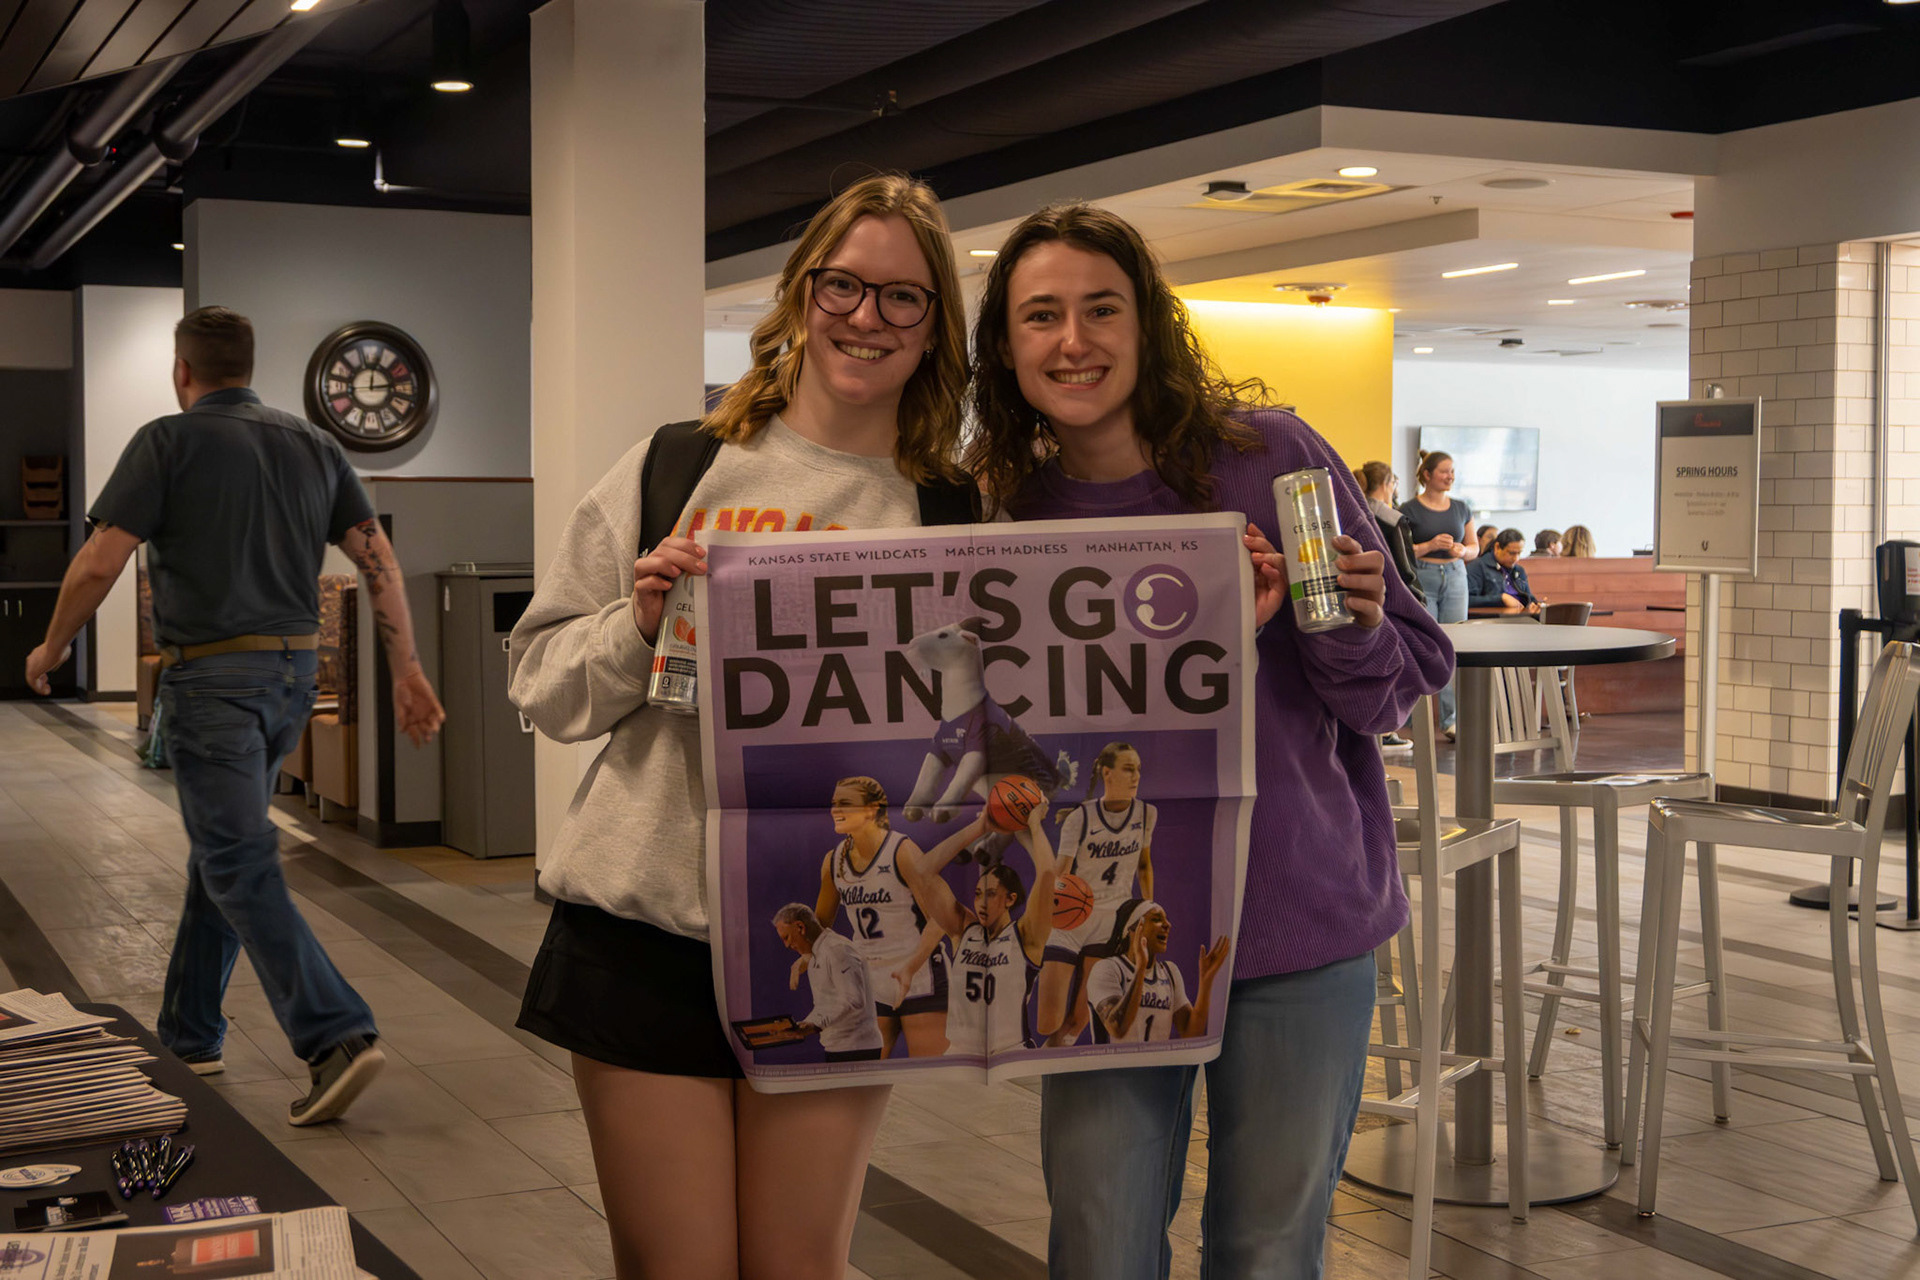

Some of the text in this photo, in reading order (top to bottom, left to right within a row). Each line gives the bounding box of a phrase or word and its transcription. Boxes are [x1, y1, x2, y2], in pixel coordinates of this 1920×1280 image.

[1676, 466, 1738, 478] SPRING HOURS
[749, 541, 1199, 566] KANSAS STATE WILDCATS MARCH MADNESS MANHATTAN, KS
[754, 568, 1022, 650] LET'S
[722, 640, 1229, 729] DANCING
[1087, 840, 1139, 859] Wildcats
[1101, 861, 1119, 885] 4
[839, 886, 893, 906] Wildcats
[856, 907, 885, 939] 12
[966, 971, 996, 1005] 50
[1145, 1014, 1155, 1042] 1
